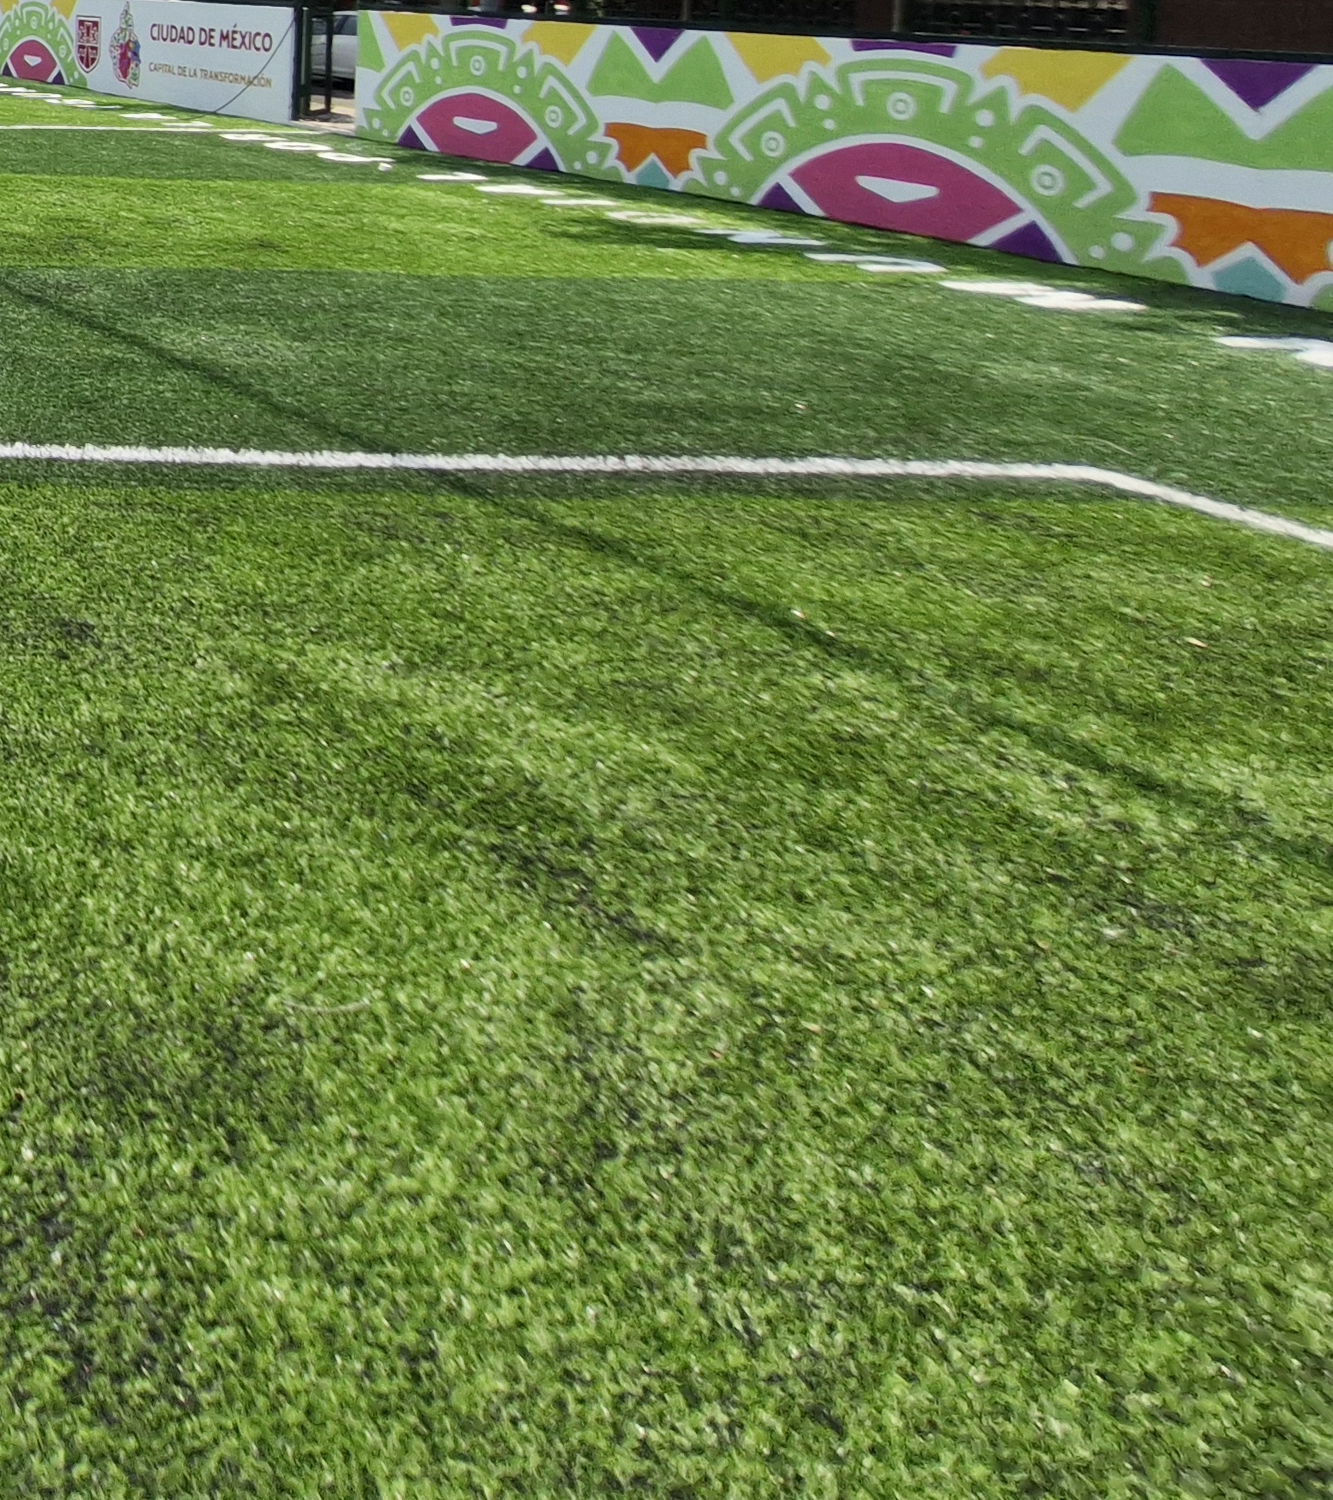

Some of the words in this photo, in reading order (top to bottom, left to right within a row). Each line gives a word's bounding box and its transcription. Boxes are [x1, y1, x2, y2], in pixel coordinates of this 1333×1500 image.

[150, 23, 195, 45] CIUDAD
[199, 27, 216, 47] DE
[219, 23, 273, 52] MÉXICO
[149, 62, 176, 76] CAPITAL
[177, 66, 188, 77] DE
[188, 68, 198, 79] LA
[199, 68, 272, 88] TRANSFORMACIÓN
